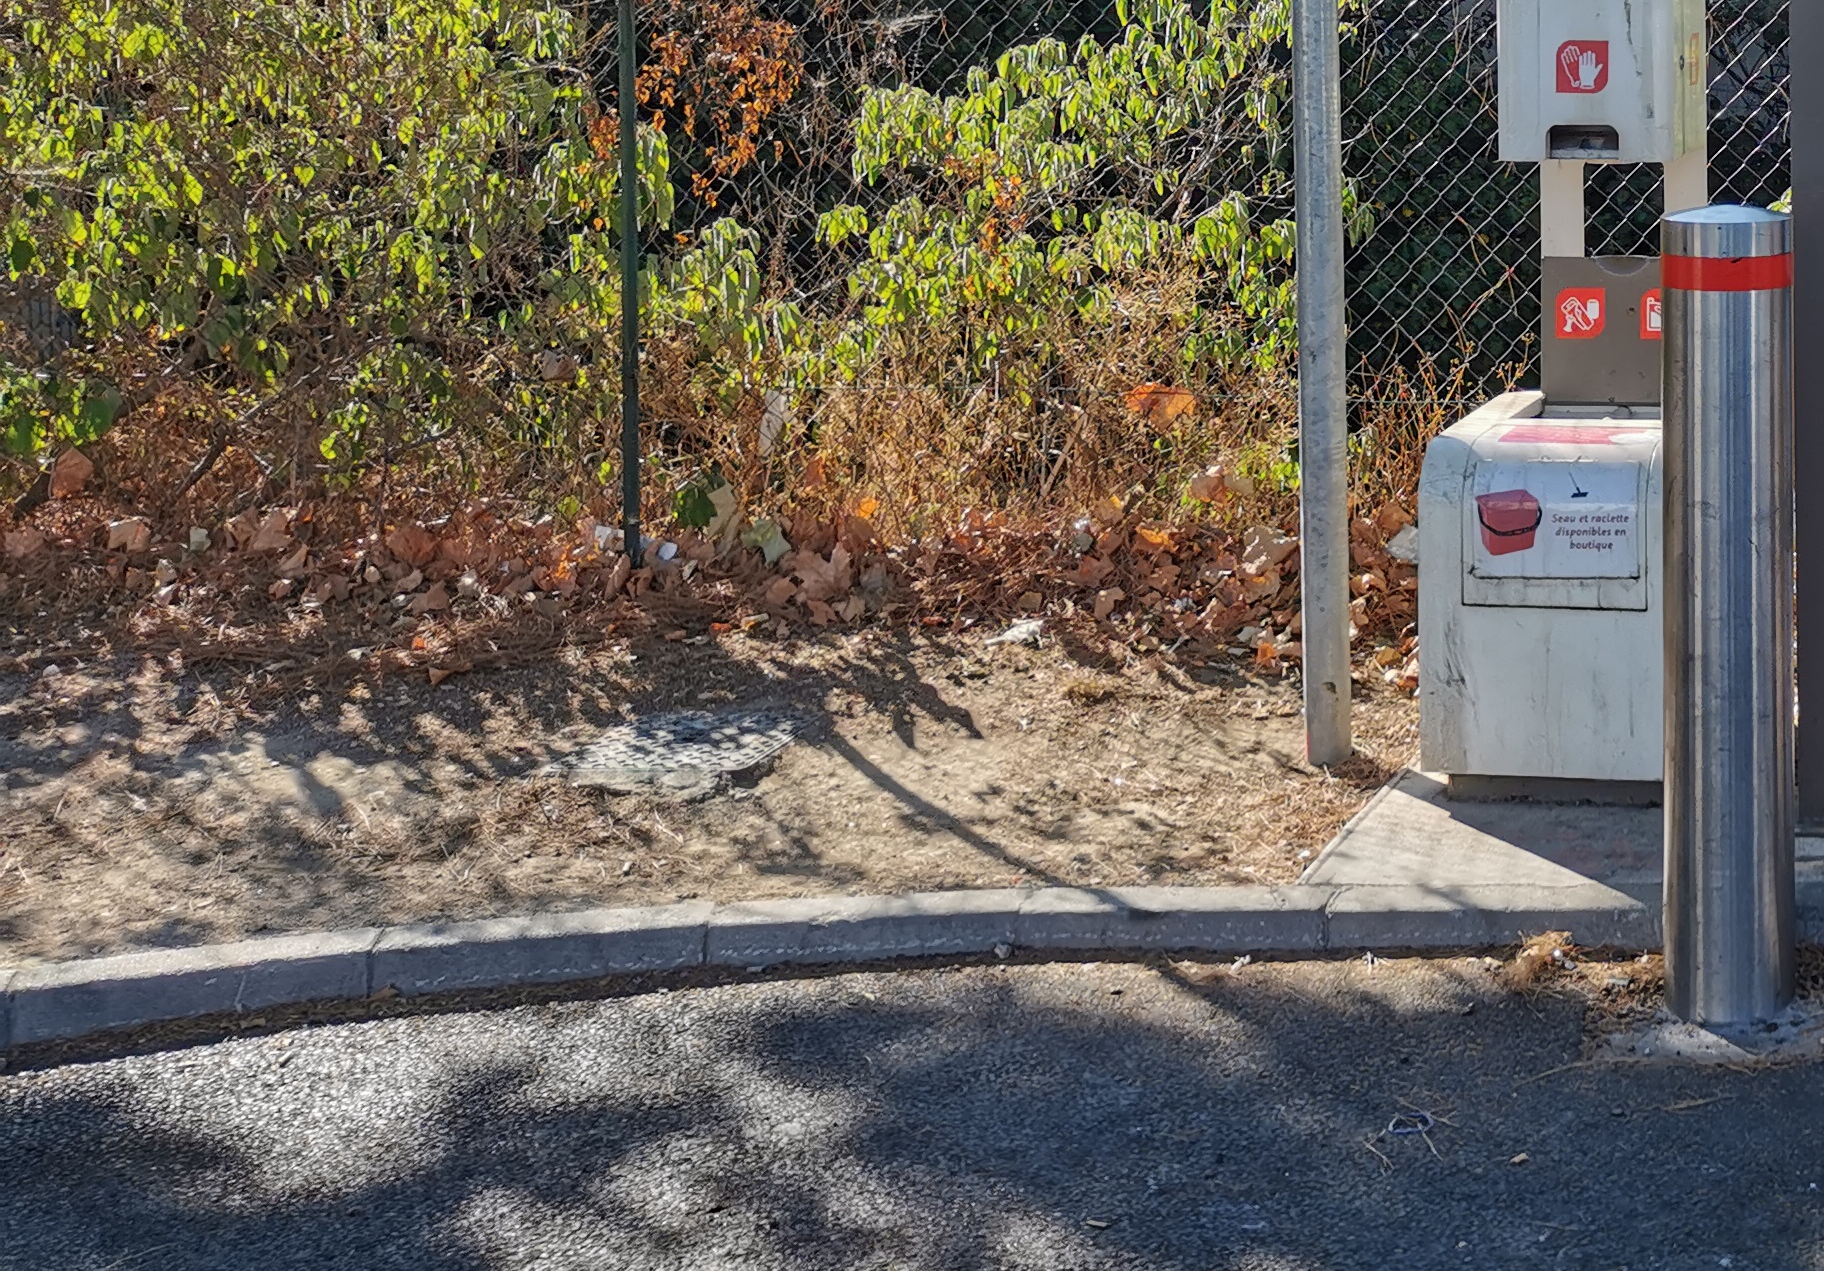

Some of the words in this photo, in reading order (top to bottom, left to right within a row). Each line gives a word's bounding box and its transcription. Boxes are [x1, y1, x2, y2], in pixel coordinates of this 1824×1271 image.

[1551, 513, 1576, 523] Seau
[1579, 514, 1588, 523] et
[1591, 513, 1630, 523] raclette
[1555, 526, 1611, 539] disponibles
[1614, 528, 1627, 536] en
[1569, 540, 1614, 553] boutique
